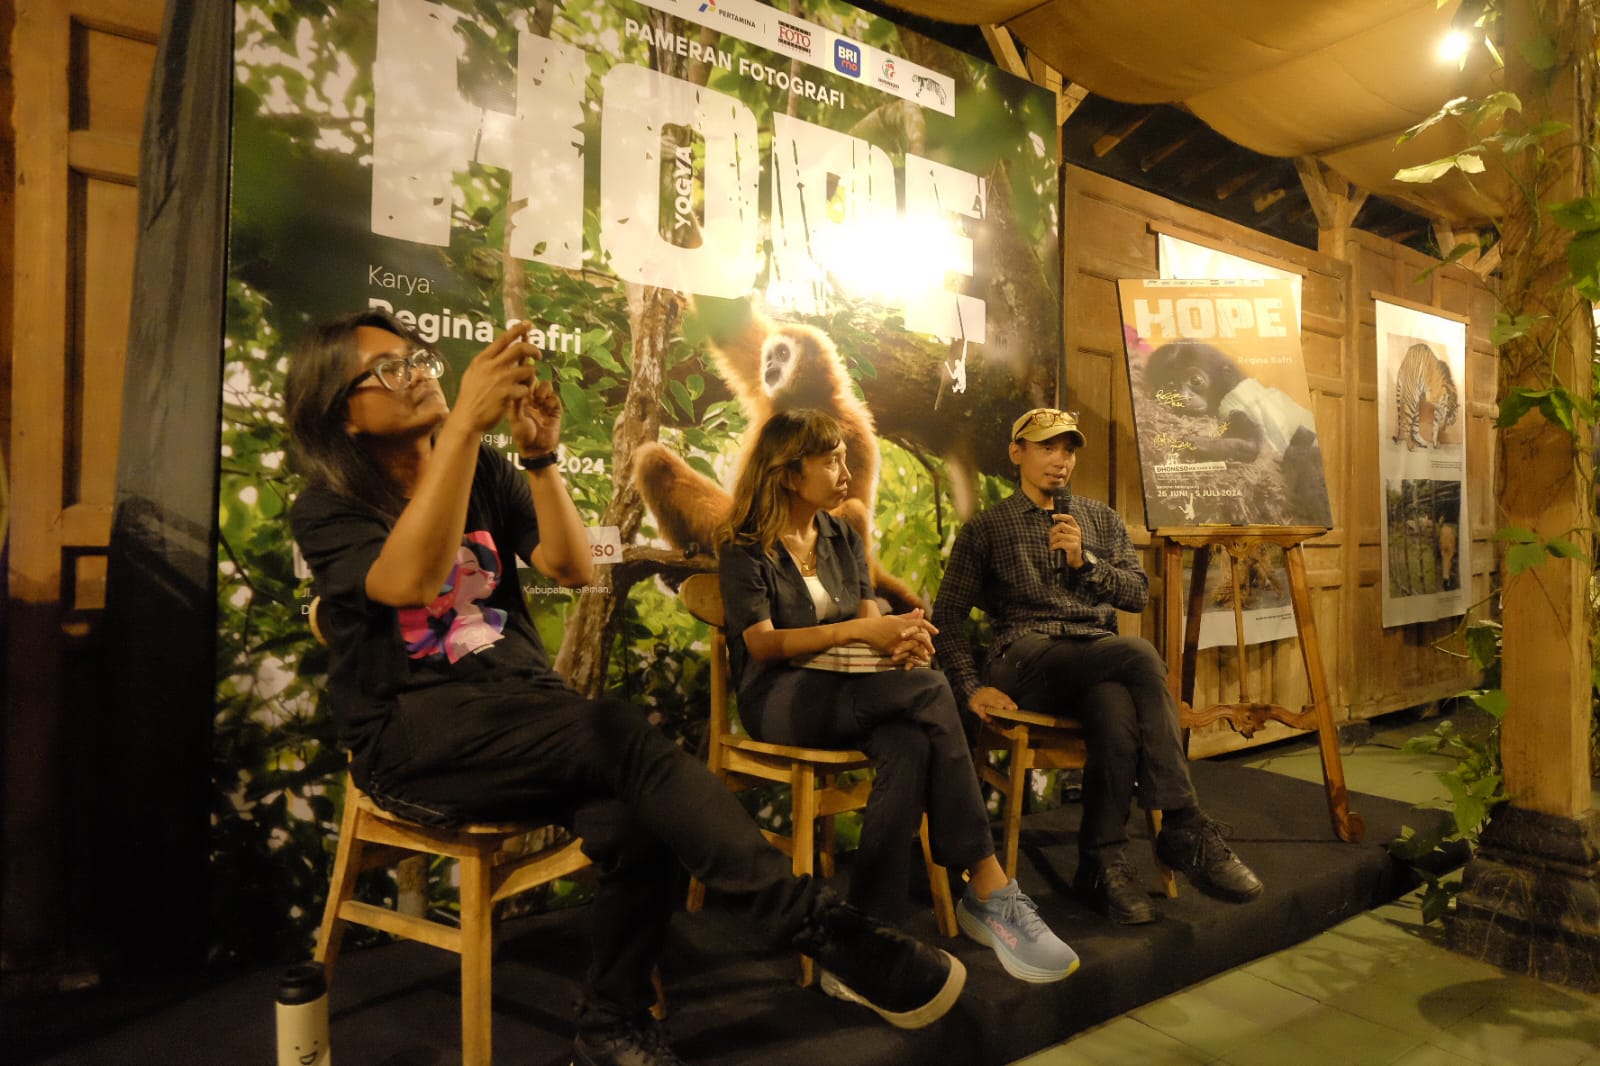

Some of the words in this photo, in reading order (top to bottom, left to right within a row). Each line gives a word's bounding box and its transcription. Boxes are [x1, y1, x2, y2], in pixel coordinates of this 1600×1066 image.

[718, 9, 756, 28] PERTAMINA
[778, 26, 811, 48] FOTO
[625, 18, 732, 71] PAMERAN
[739, 57, 845, 110] FOTOGRAFI
[838, 45, 858, 62] BRI
[841, 60, 858, 72] mo
[371, 0, 986, 346] HOPE
[674, 146, 693, 230] YOGYA
[368, 264, 434, 296] Karya:
[1134, 298, 1287, 338] HOPE
[557, 456, 605, 474] 2024
[1157, 489, 1168, 497] 26
[1170, 489, 1189, 497] JUNI
[1203, 489, 1220, 497] JULI
